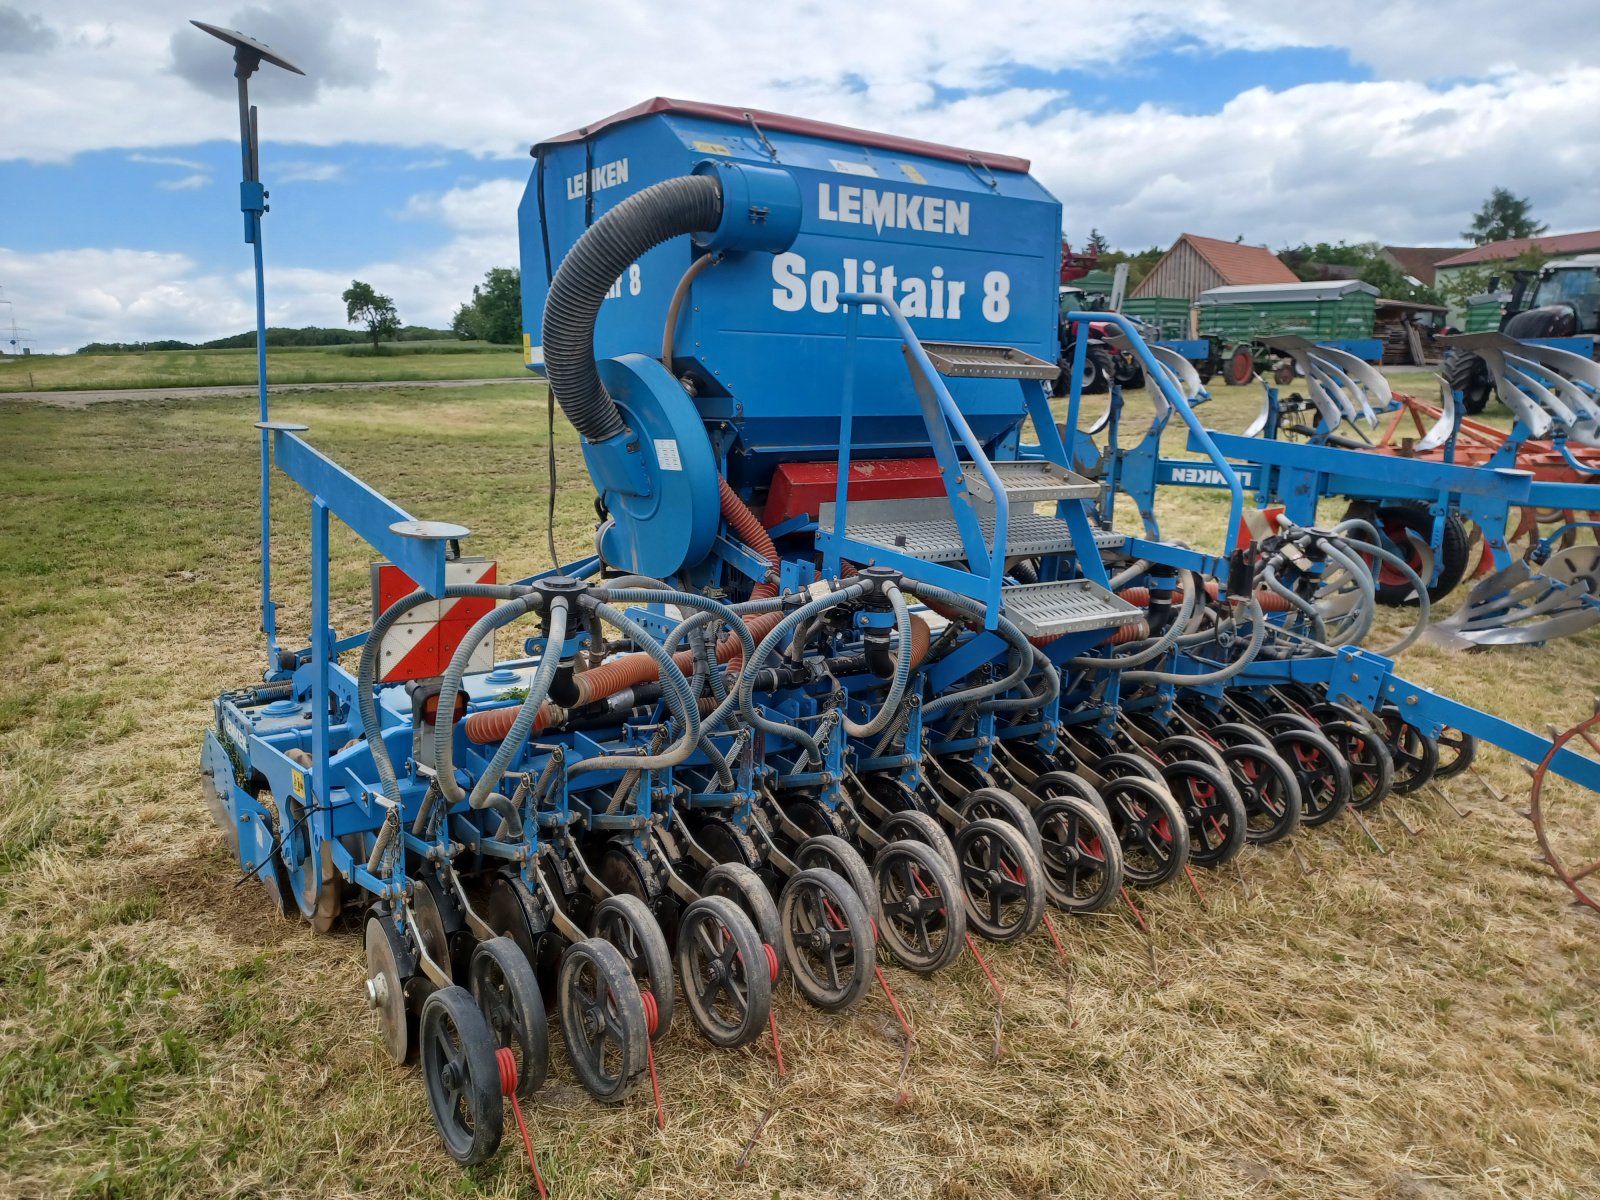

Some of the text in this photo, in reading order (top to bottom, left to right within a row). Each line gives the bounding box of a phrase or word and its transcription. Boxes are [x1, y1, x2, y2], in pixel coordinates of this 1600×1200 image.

[818, 182, 970, 237] LEMKEN
[629, 263, 641, 296] 8
[771, 251, 1011, 323] Solitair 8
